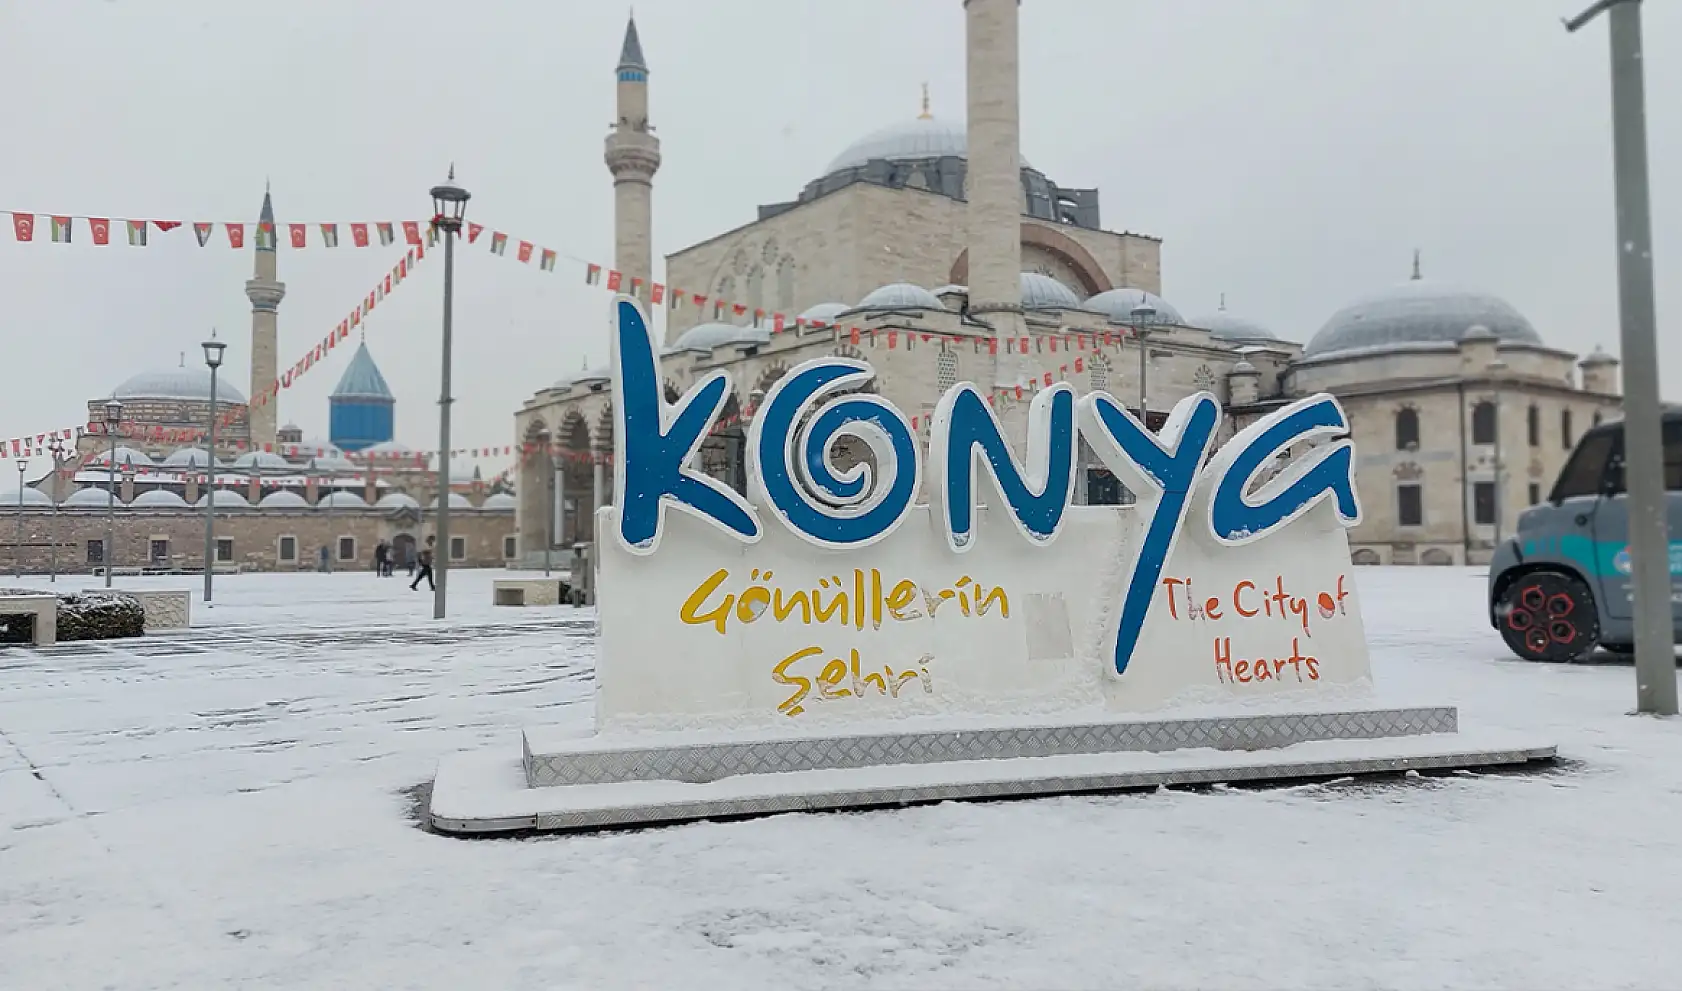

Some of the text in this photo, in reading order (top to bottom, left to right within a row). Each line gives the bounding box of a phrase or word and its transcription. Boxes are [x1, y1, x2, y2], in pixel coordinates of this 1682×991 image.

[679, 567, 1009, 635] Gönüllerin
[1162, 574, 1349, 638] The City of
[772, 646, 934, 717] Şehri
[1214, 636, 1320, 684] Hearts
